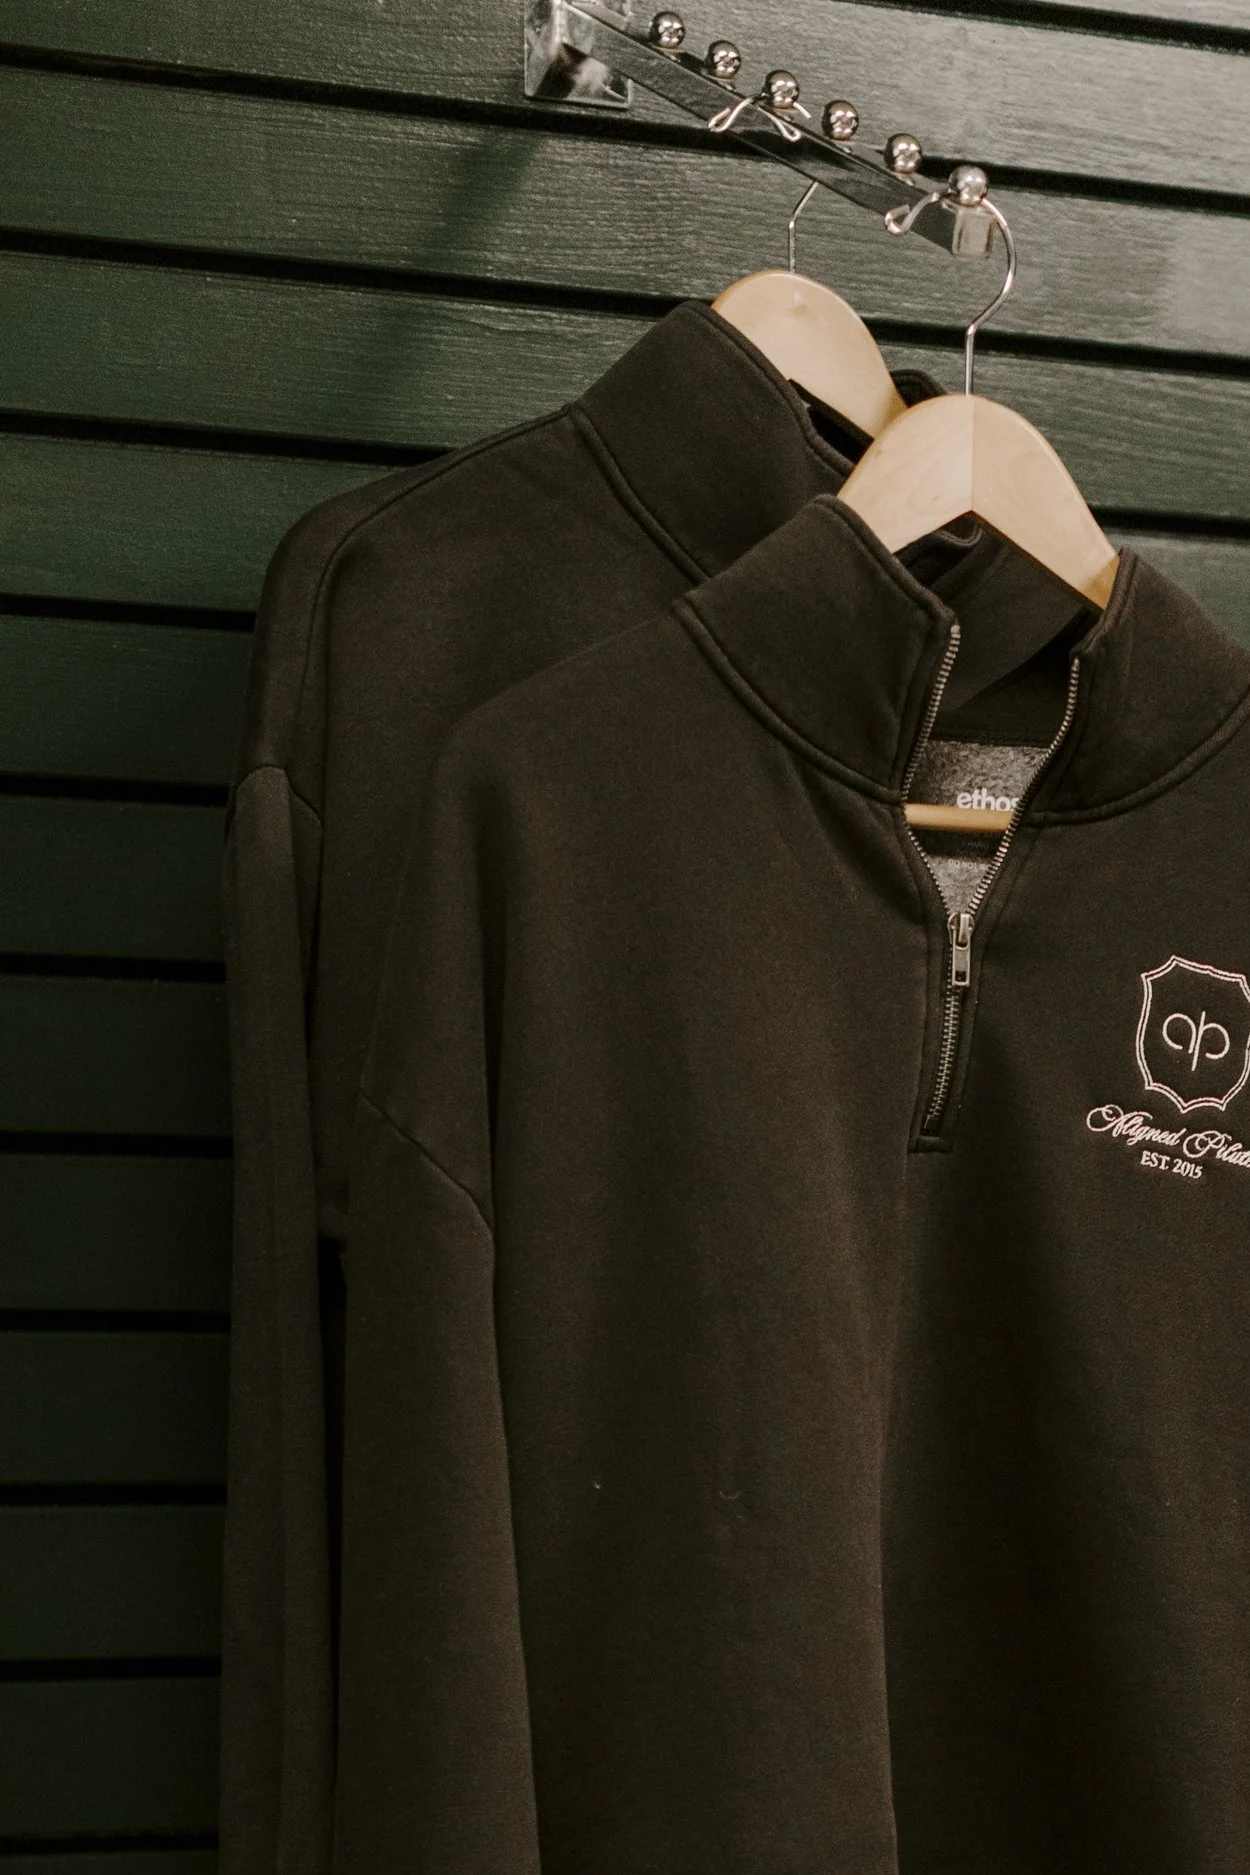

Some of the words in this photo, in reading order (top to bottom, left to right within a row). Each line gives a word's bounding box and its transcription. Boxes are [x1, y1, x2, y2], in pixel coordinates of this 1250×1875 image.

[1087, 1104, 1187, 1145] Aligned
[1140, 1150, 1169, 1171] EST.
[1172, 1158, 1203, 1179] 2015
